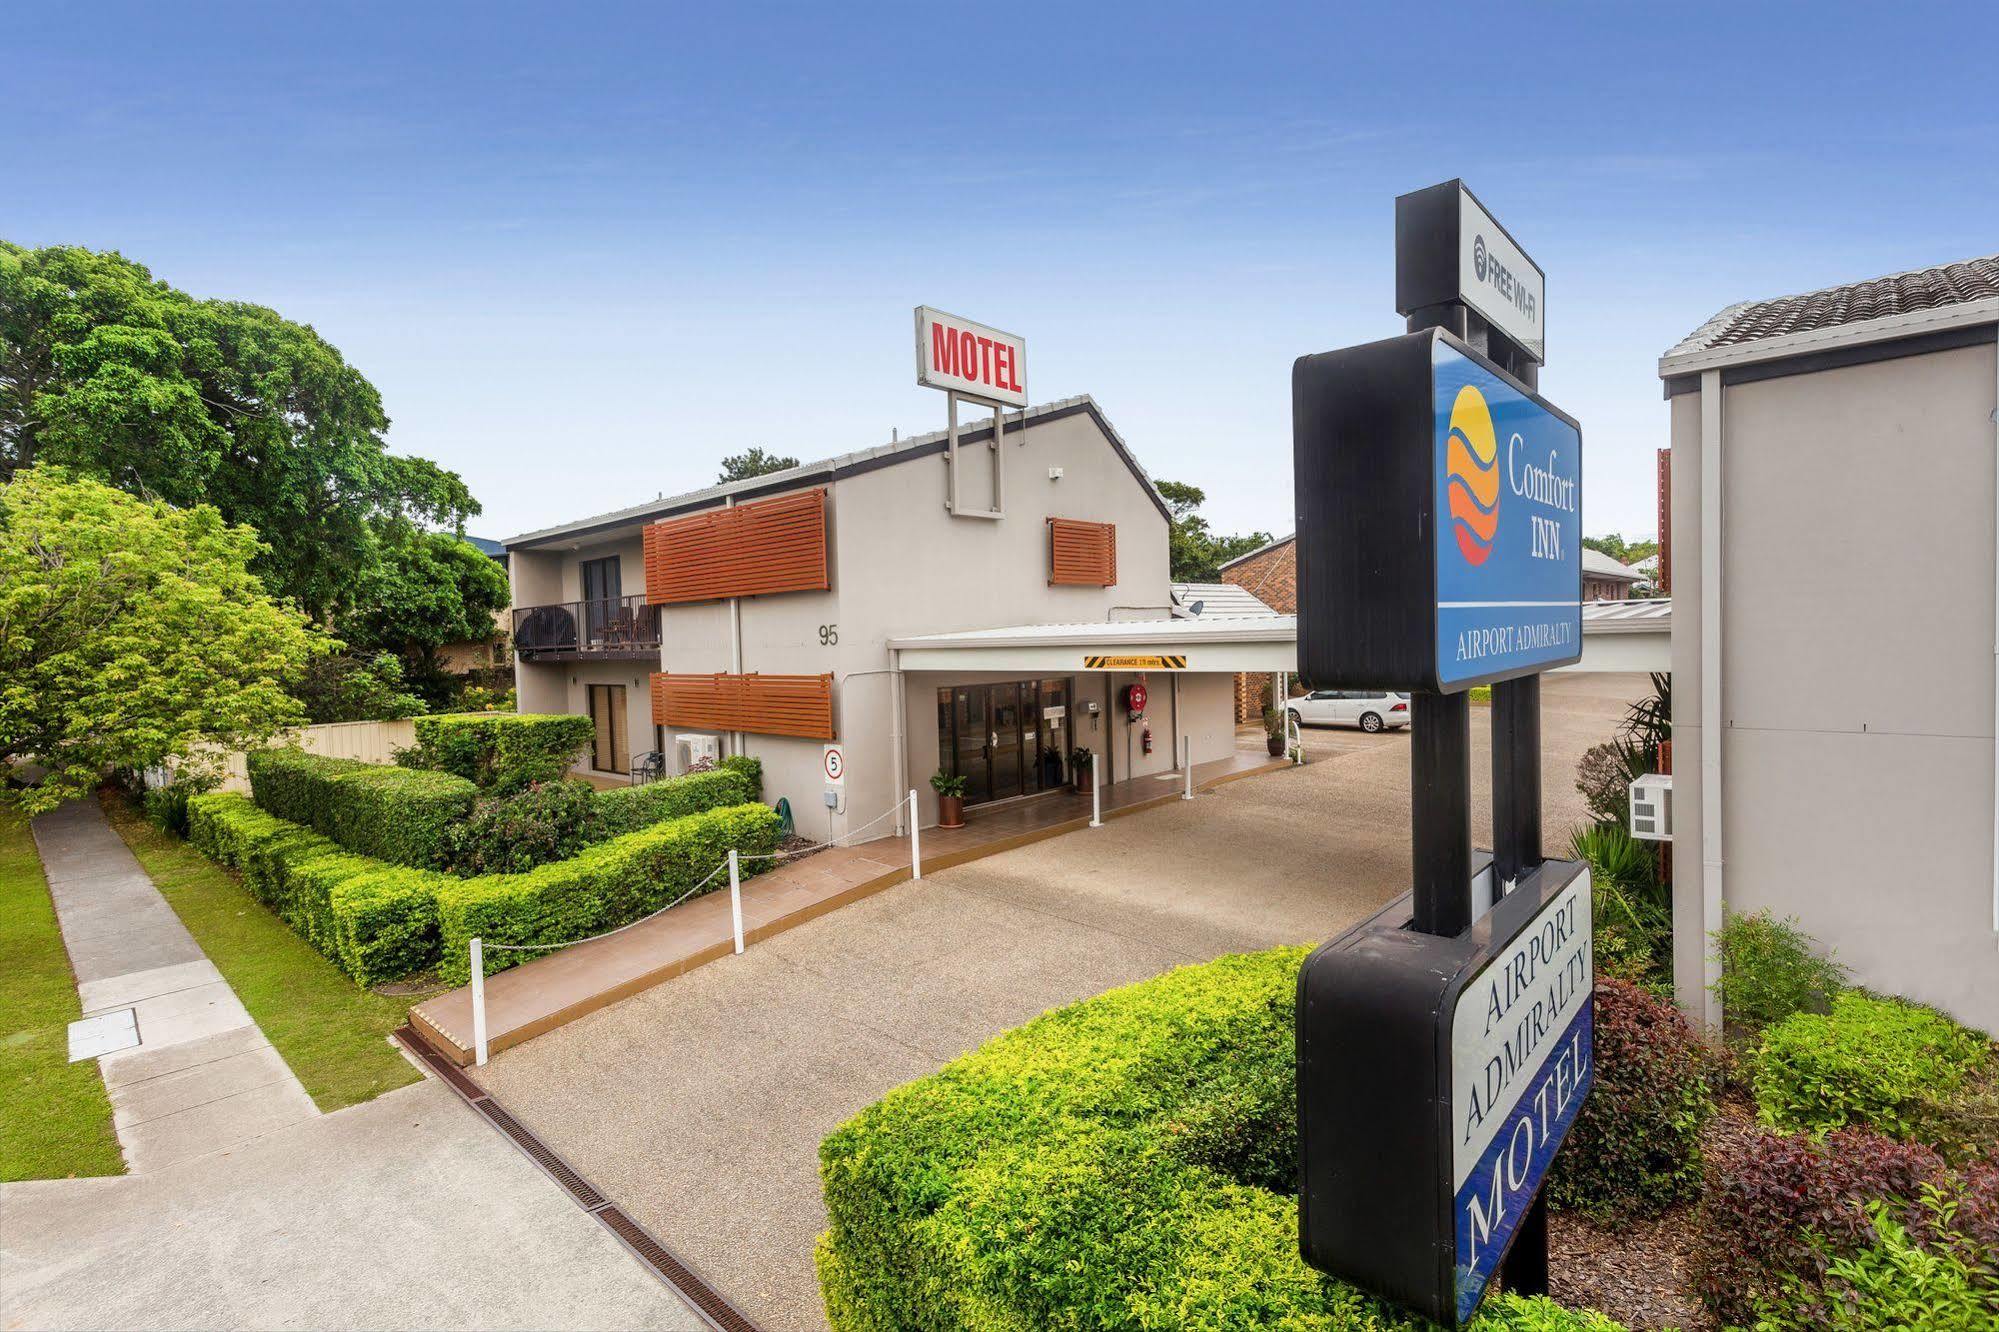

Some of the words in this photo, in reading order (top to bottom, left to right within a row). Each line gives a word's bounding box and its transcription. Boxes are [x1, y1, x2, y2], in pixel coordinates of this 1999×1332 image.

[1488, 252, 1513, 303] FREE
[1513, 278, 1536, 324] WI-FI
[932, 321, 1022, 394] MOTEL
[1508, 432, 1575, 513] Comfort
[1531, 515, 1560, 561] INN
[818, 624, 839, 646] 95
[1106, 658, 1138, 666] CLEARANCE
[1456, 626, 1514, 662] AIRPORT
[1515, 622, 1571, 651] ADMIRALTY
[830, 756, 838, 772] 5
[1483, 894, 1578, 1038] AIRPORT
[1463, 940, 1588, 1147] ADMIRALTY
[1466, 1030, 1588, 1277] MOTEL
